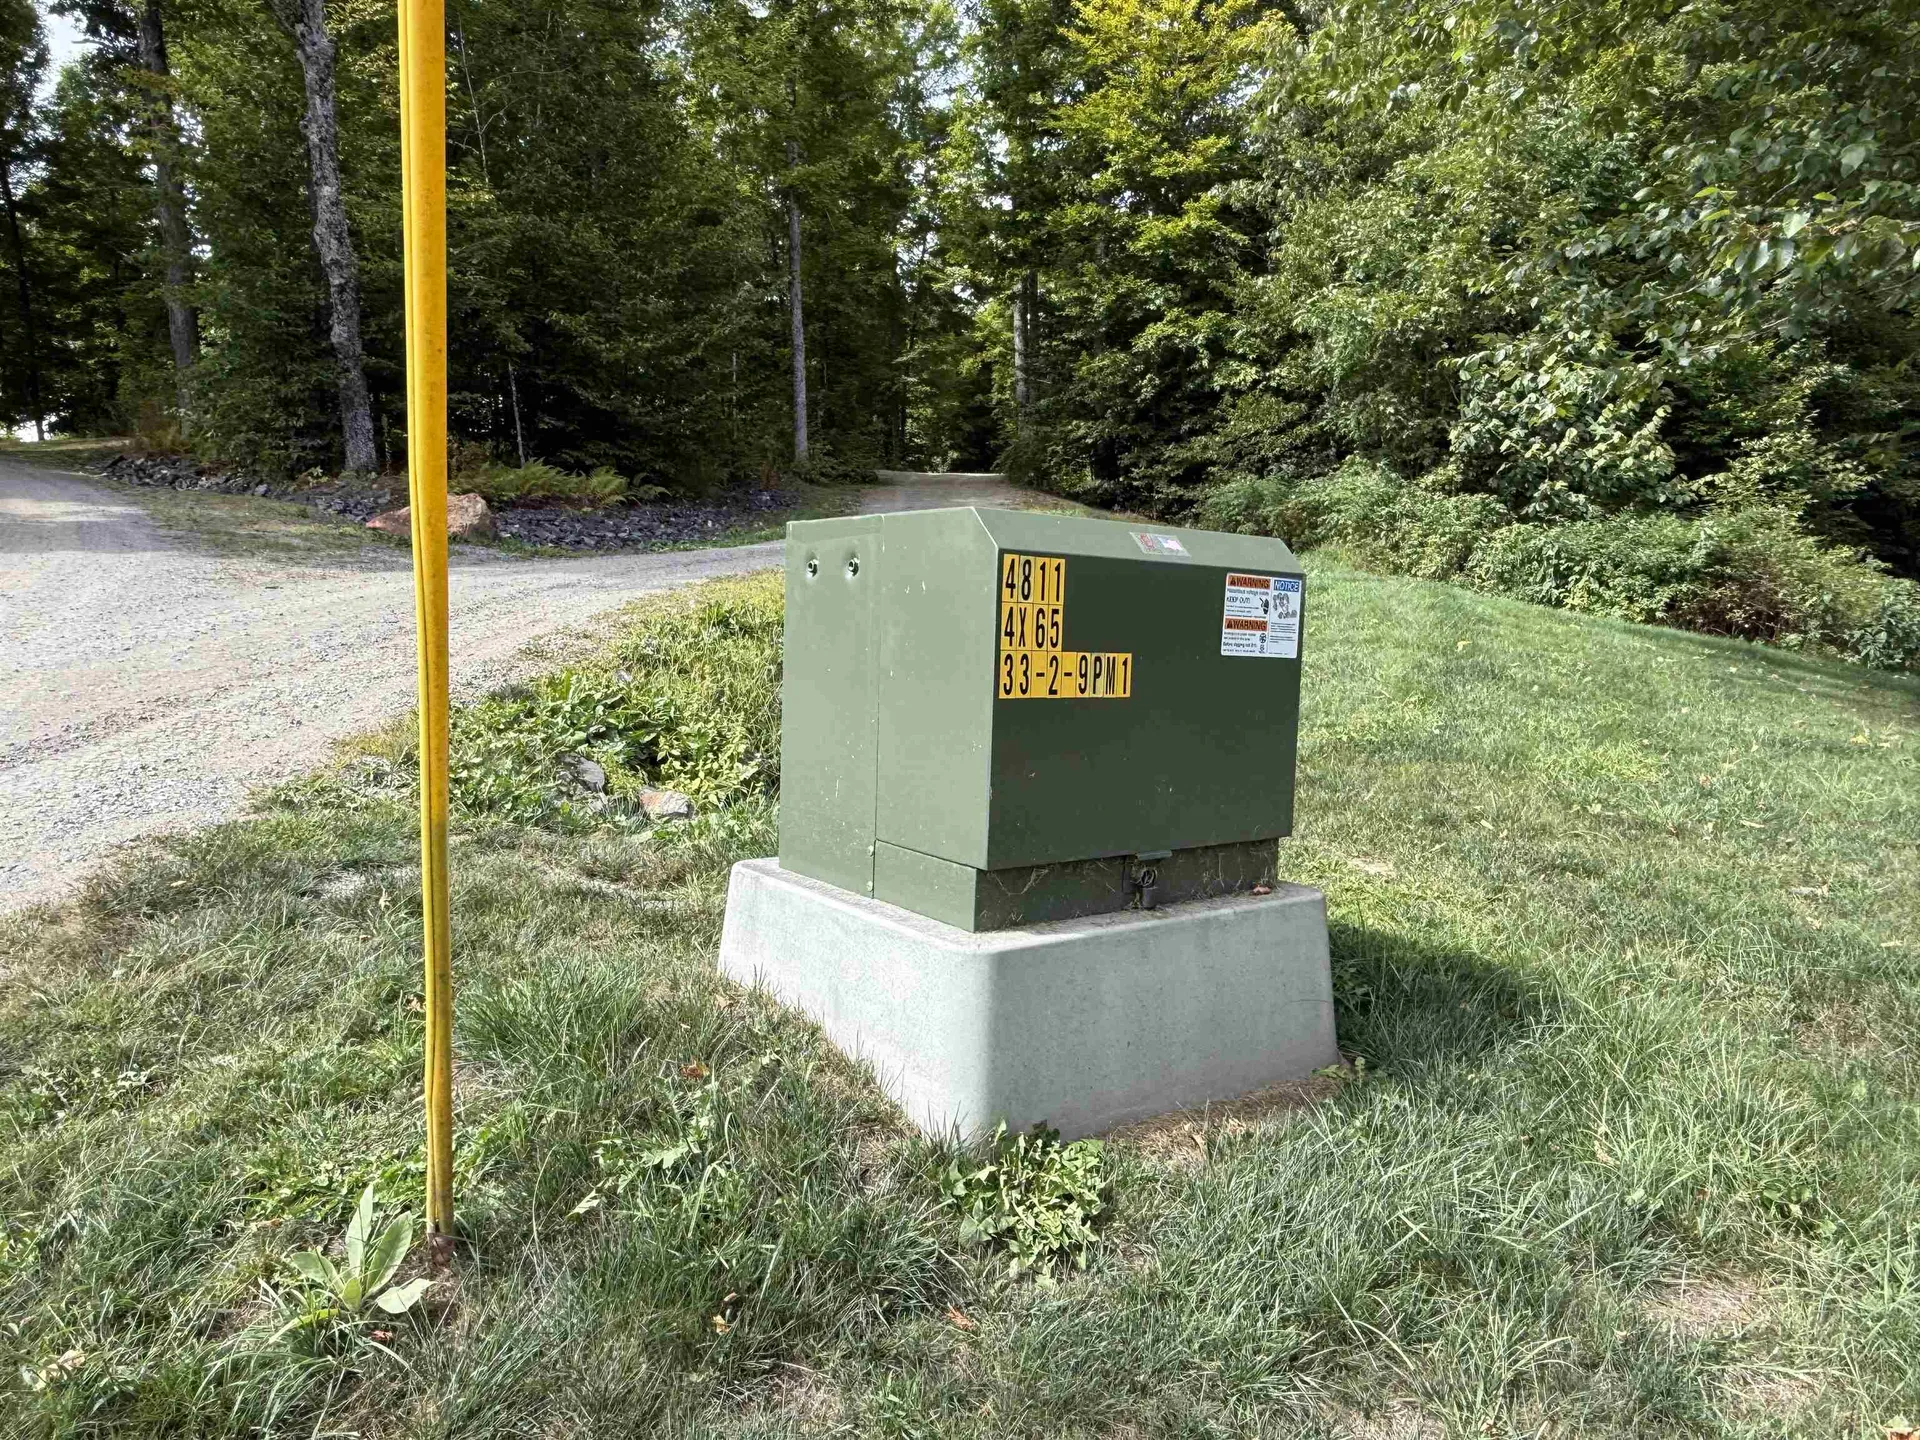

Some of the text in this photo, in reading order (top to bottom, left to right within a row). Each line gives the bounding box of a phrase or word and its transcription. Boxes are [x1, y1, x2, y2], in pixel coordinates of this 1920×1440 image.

[1005, 558, 1061, 602] 4811
[1235, 576, 1270, 589] WARNING
[1274, 580, 1299, 591] NOTICE
[1004, 606, 1060, 649] 4X65
[1232, 619, 1267, 631] WARNING
[1003, 653, 1129, 696] 33-2-9PM1
